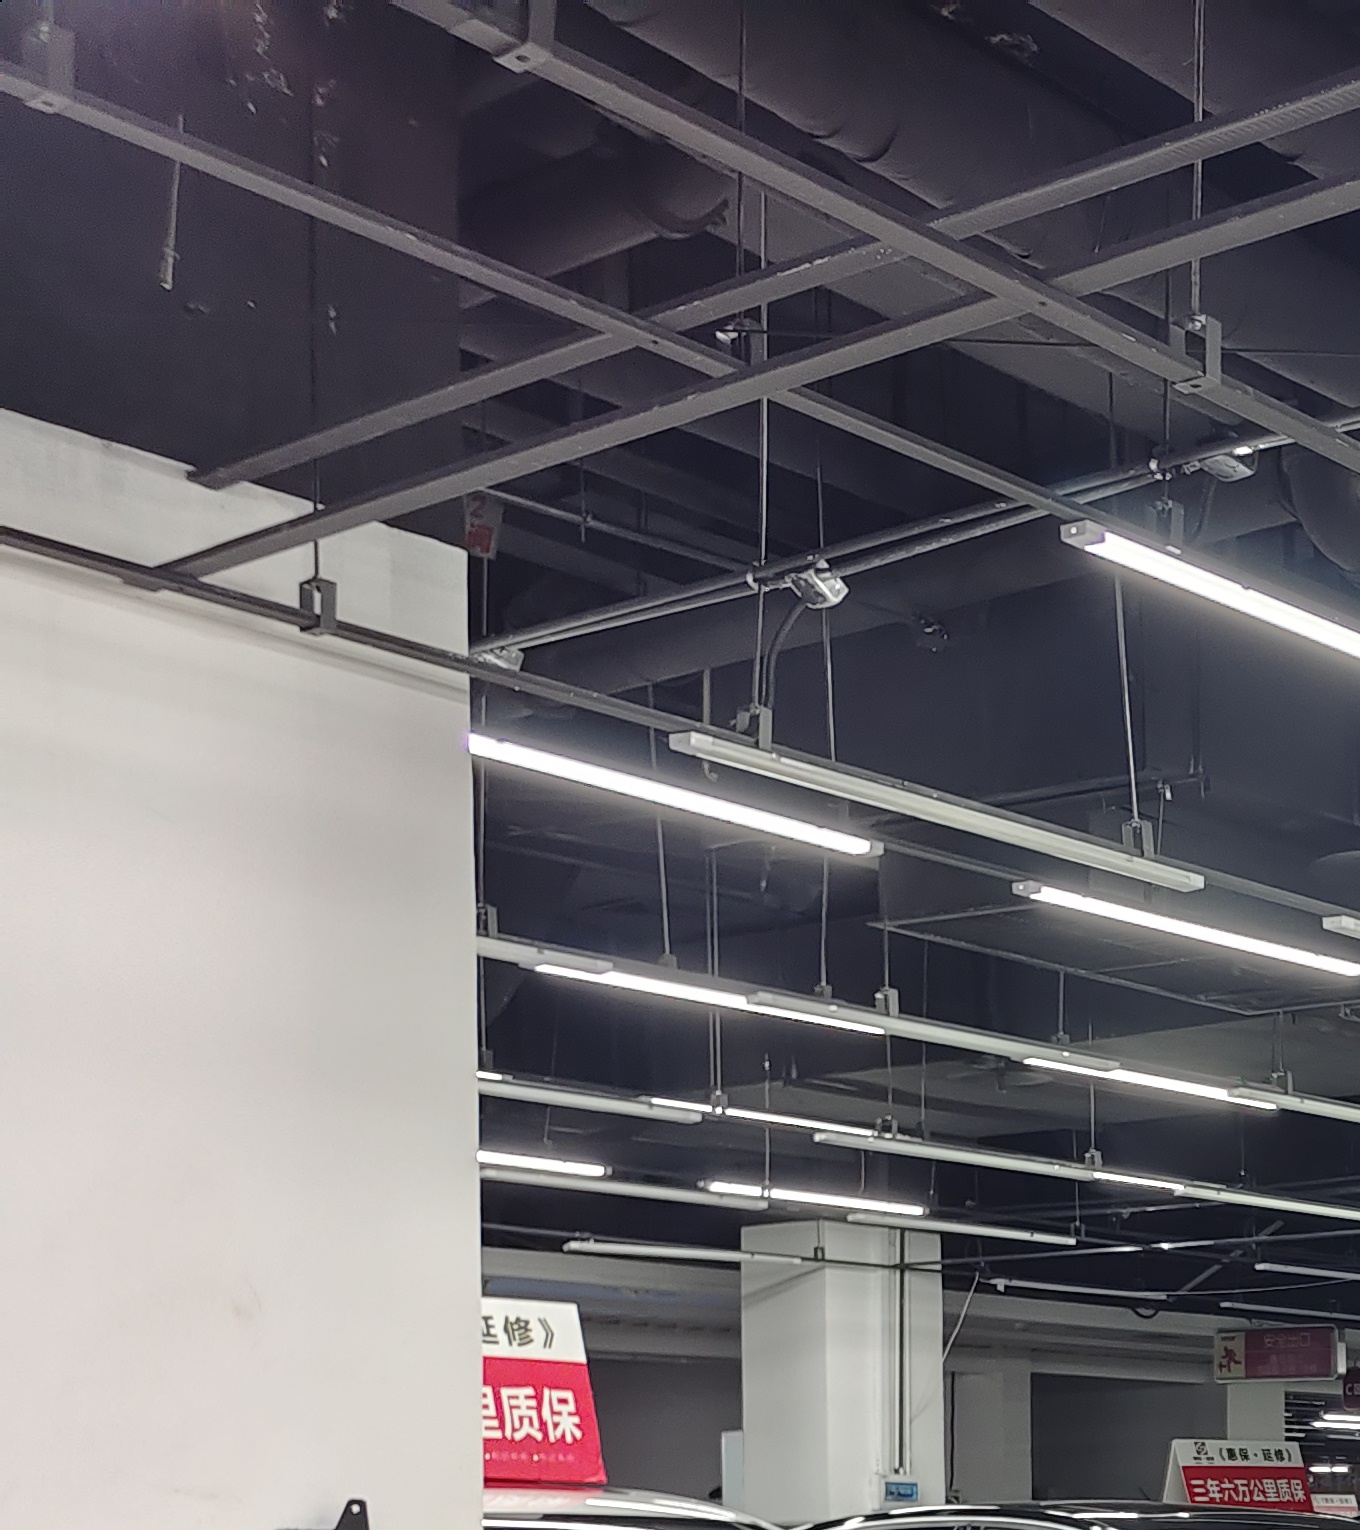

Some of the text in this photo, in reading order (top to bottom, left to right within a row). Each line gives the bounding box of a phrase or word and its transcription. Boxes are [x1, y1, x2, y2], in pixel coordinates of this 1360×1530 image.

[1190, 1478, 1307, 1502] 三年六万公里质保
